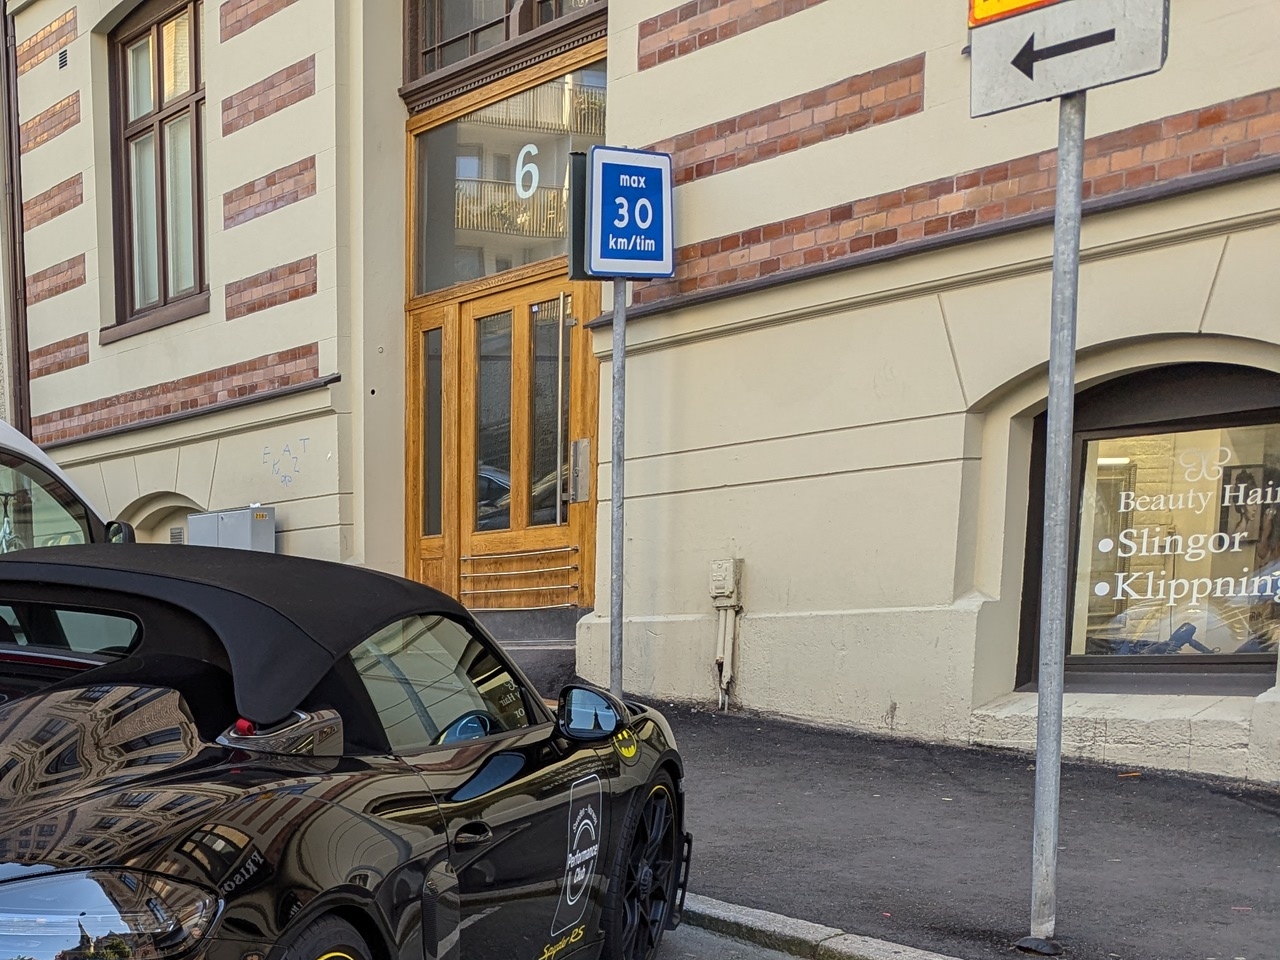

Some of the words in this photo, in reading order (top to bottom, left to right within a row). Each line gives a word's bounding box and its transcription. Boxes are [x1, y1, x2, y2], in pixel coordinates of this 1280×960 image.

[515, 143, 540, 199] 6
[620, 174, 646, 188] max
[613, 196, 653, 229] 30
[609, 234, 655, 251] km/tim
[1118, 488, 1214, 514] Beauty
[1117, 527, 1249, 562] Slingor
[1111, 567, 1280, 607] Klippnin
[568, 844, 598, 868] Performance
[573, 864, 586, 883] Club
[569, 925, 586, 944] RS
